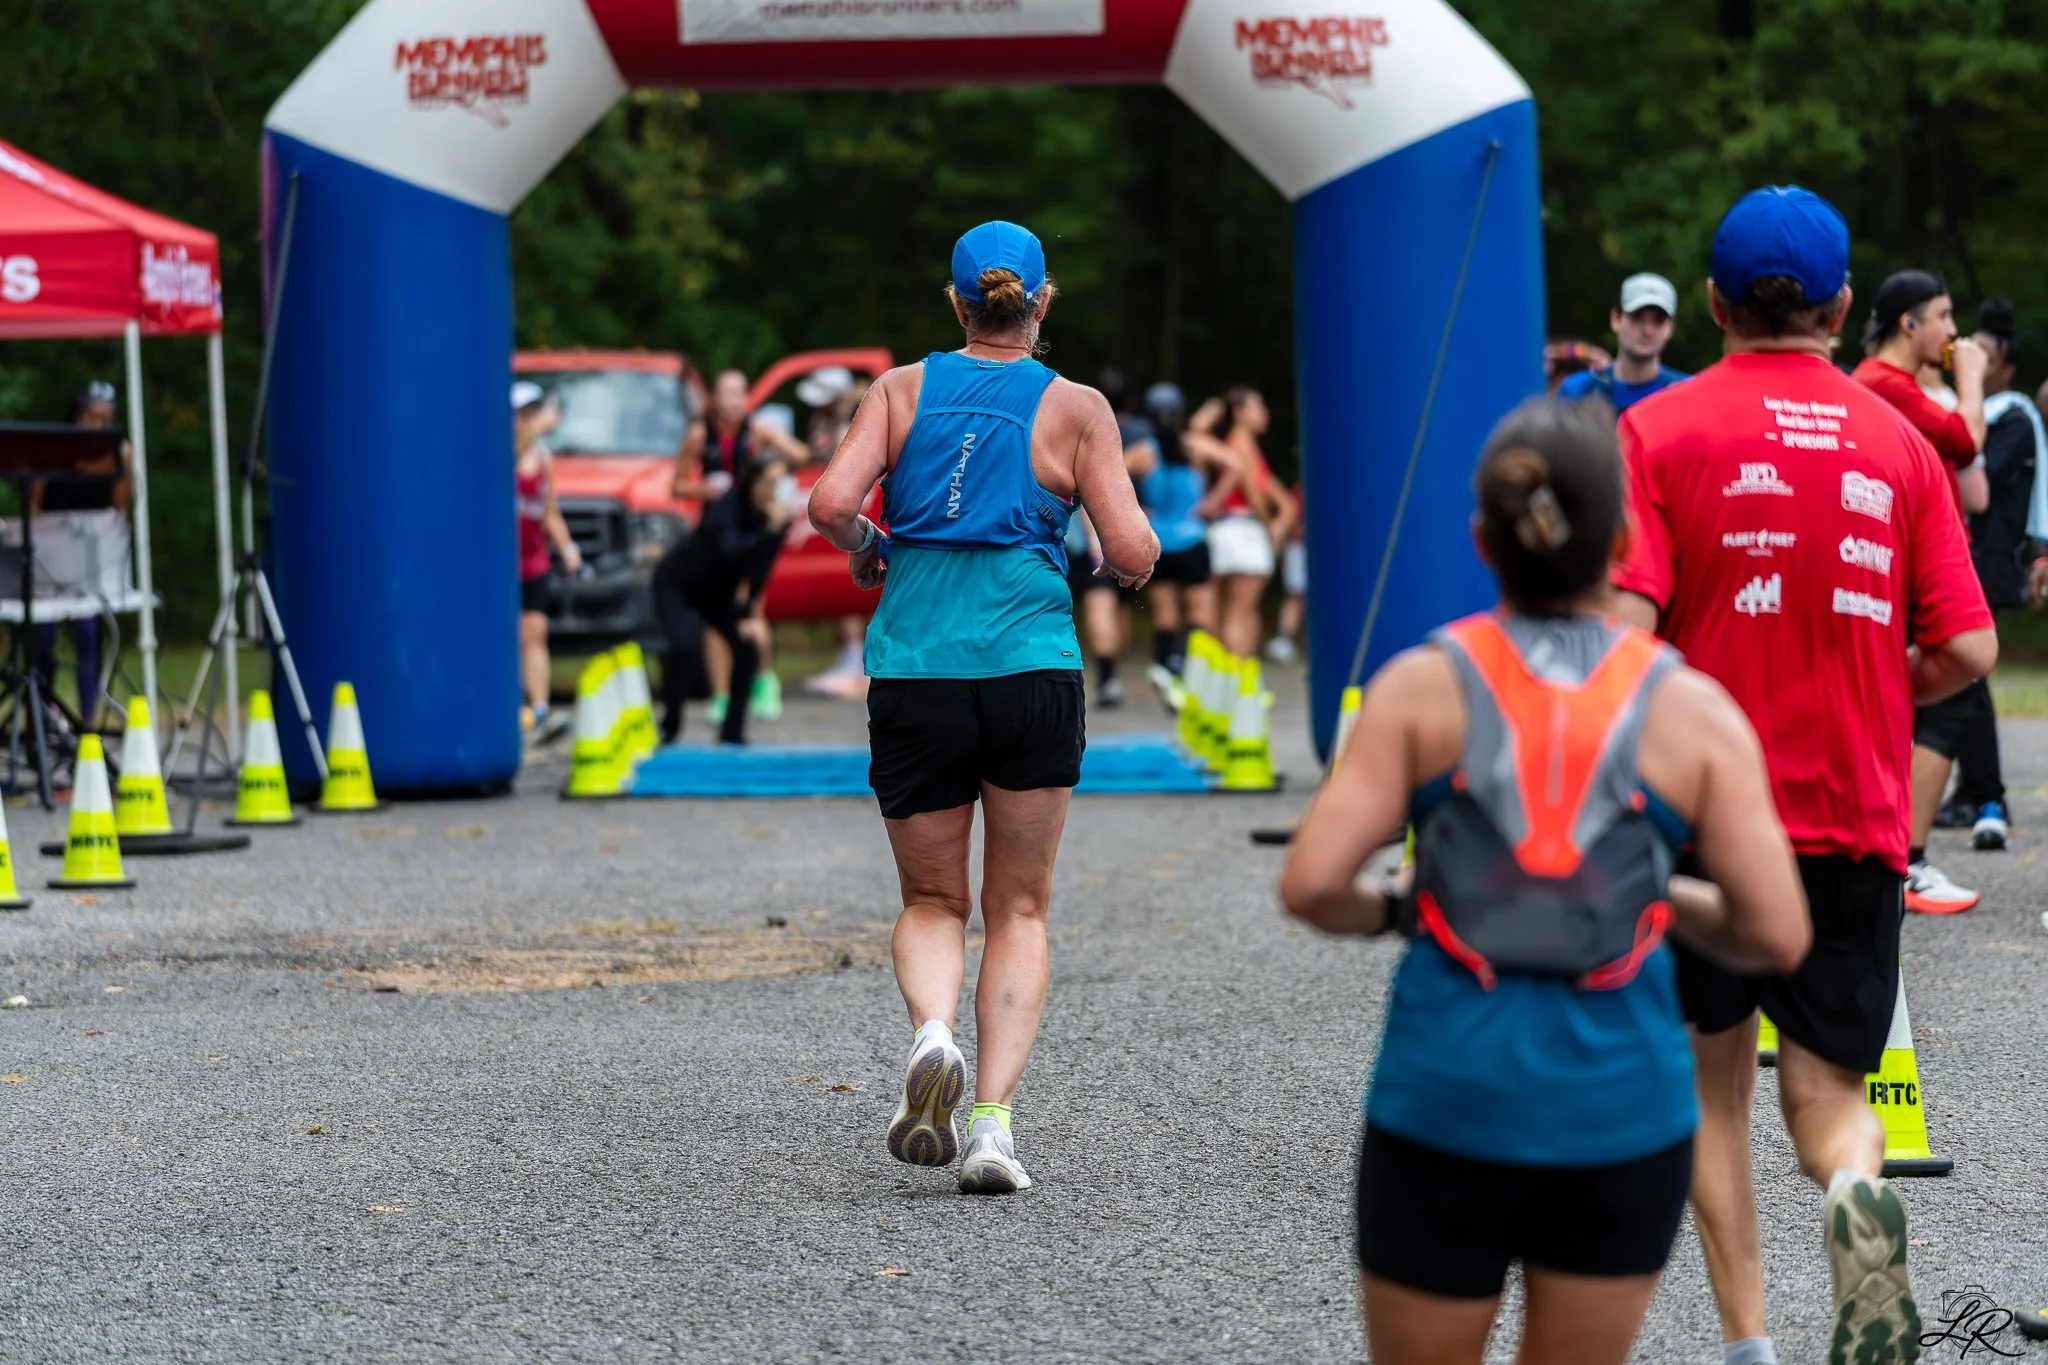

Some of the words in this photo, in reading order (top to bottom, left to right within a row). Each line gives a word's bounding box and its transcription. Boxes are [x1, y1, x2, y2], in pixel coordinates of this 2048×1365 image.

[1234, 17, 1389, 49] MEMPHIS
[395, 34, 548, 69] MEMPHIS
[1782, 431, 1839, 451] SPONSORS
[946, 433, 977, 518] NATHAN
[1865, 1081, 1917, 1106] RTC
